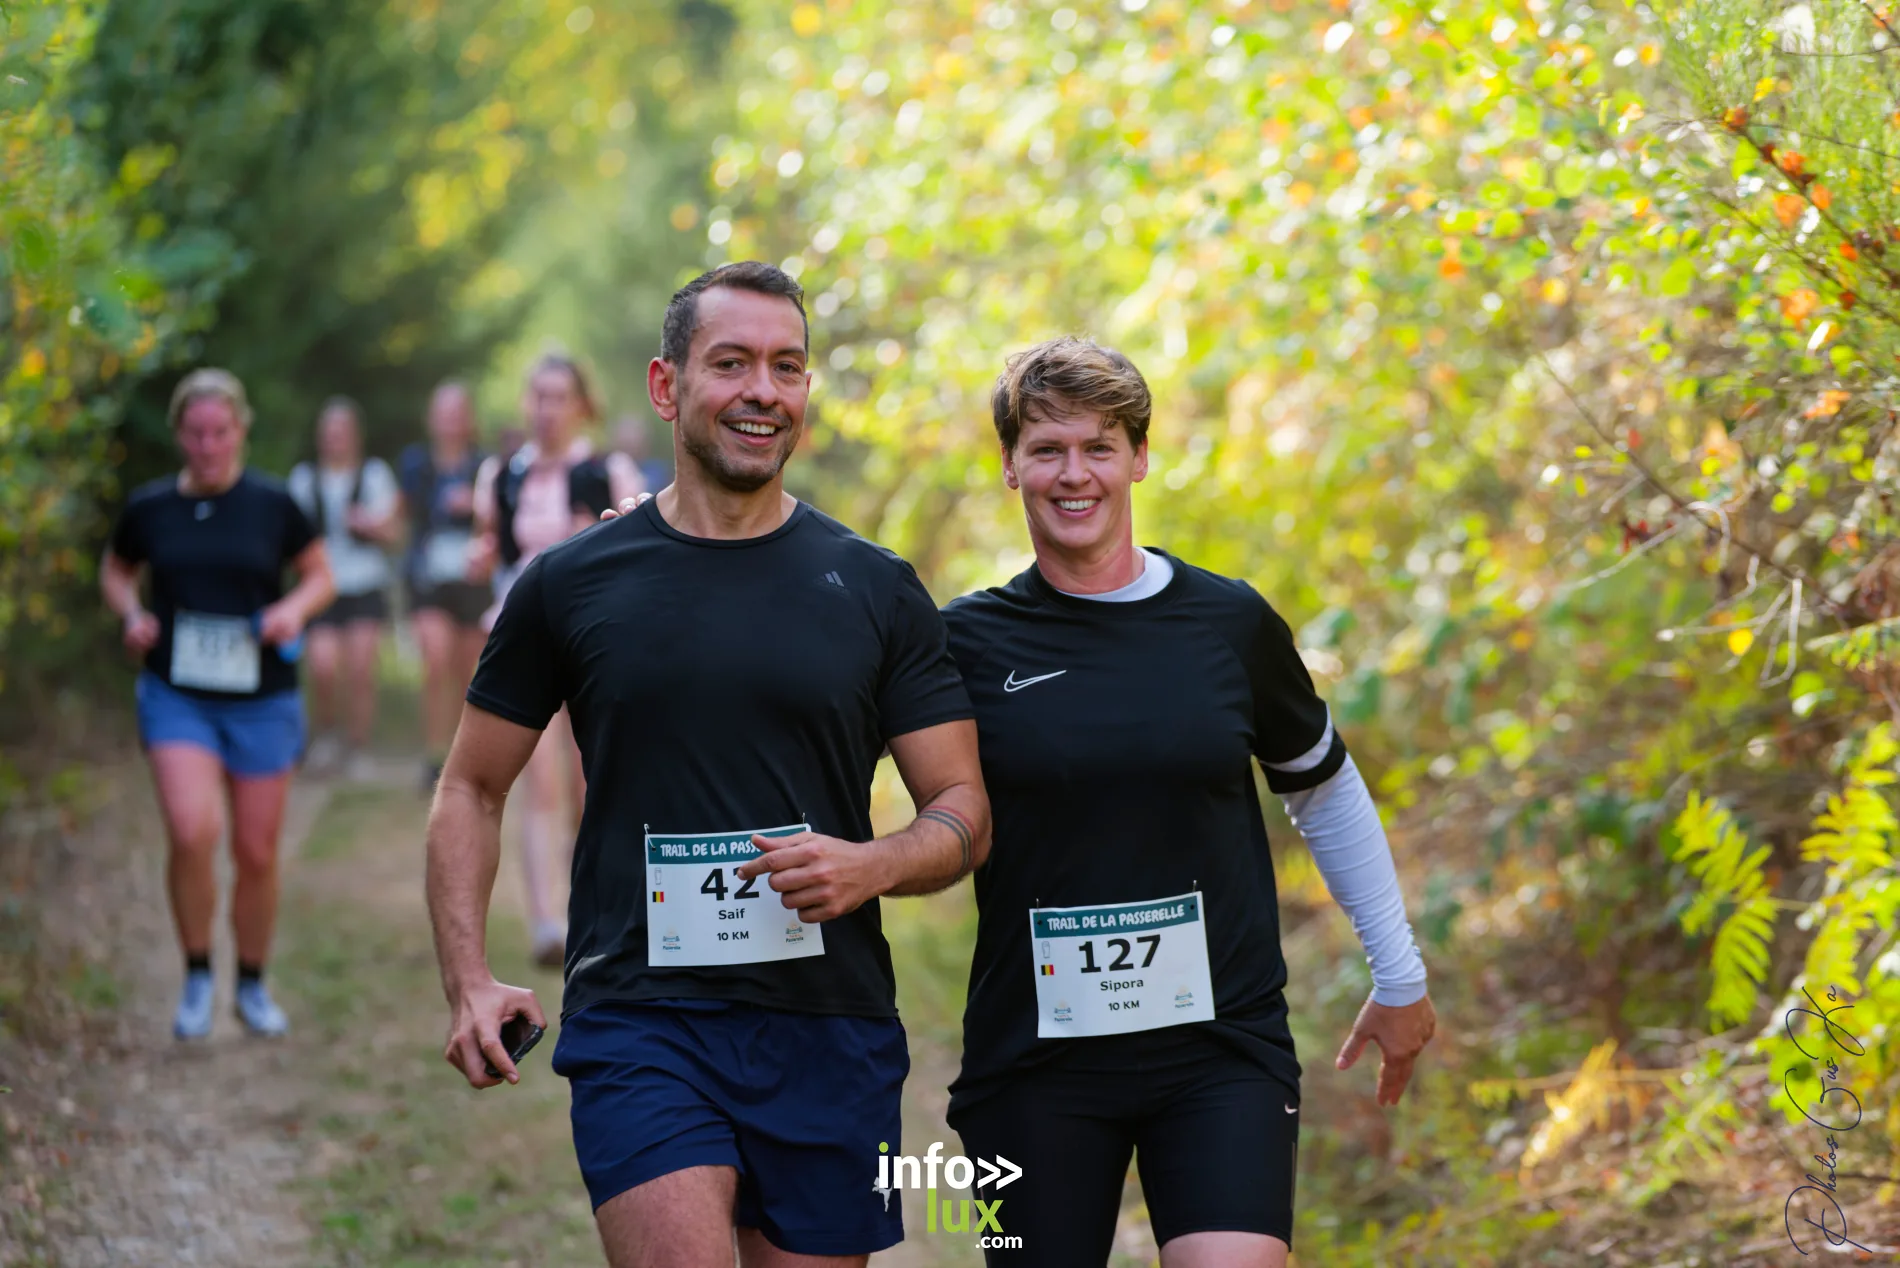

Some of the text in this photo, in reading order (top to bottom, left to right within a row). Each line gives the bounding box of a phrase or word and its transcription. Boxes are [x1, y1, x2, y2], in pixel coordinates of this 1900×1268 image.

[660, 843, 690, 857] TRAIL
[692, 843, 707, 857] DE
[710, 842, 726, 855] LA
[700, 867, 760, 901] 42
[718, 908, 745, 920] Saif
[1047, 904, 1185, 931] TRAIL DE LA PASSERELLE
[717, 931, 749, 941] 10 KM
[1078, 934, 1161, 974] 127
[1100, 979, 1144, 992] Sipora
[1108, 1000, 1140, 1011] 10 KM
